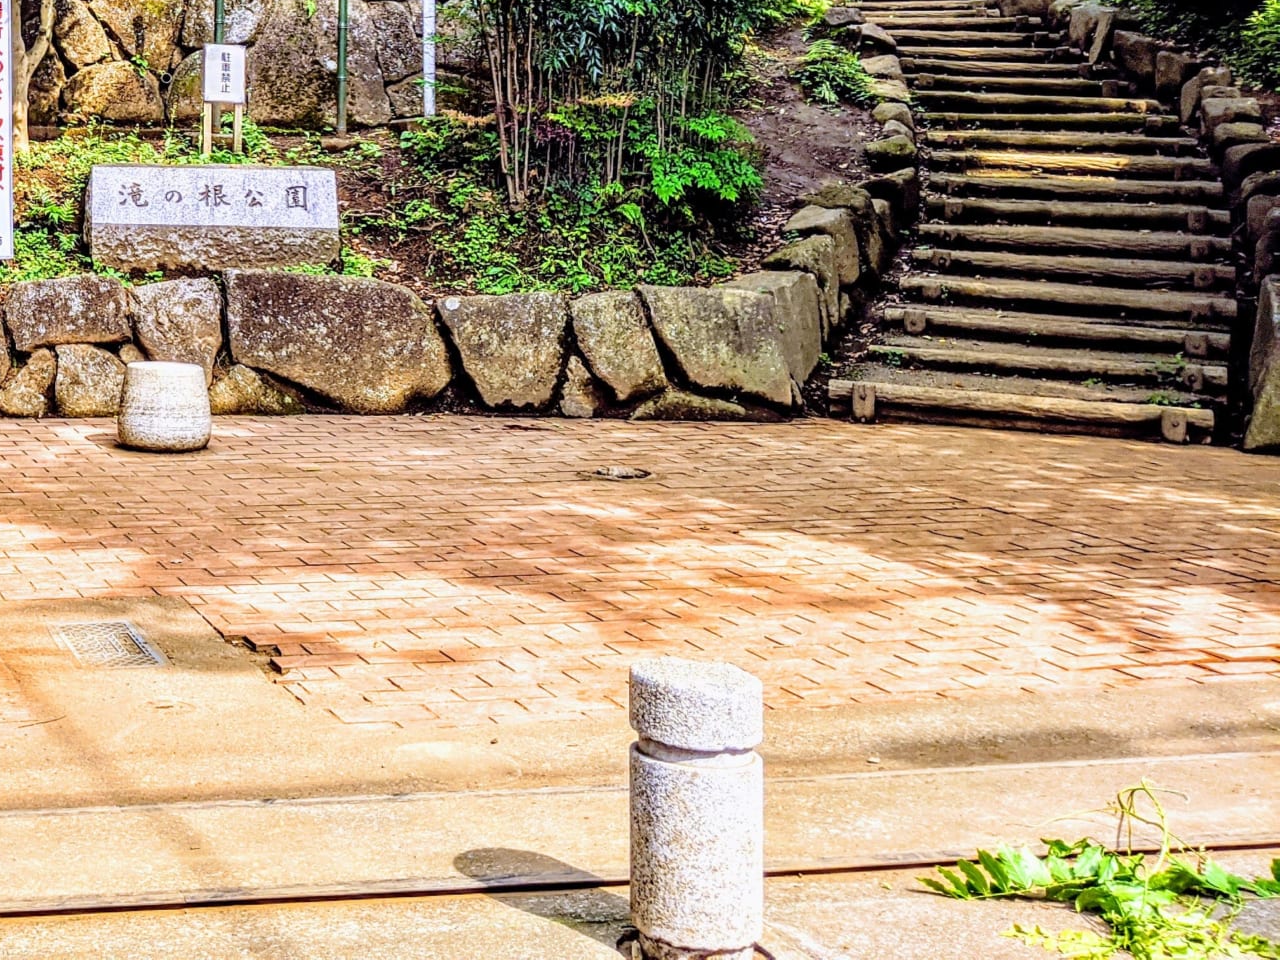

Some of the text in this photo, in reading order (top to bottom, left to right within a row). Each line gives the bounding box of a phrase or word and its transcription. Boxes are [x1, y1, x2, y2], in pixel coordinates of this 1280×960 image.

[221, 52, 231, 93] 駐車禁止
[119, 182, 308, 211] 滝の根公園
